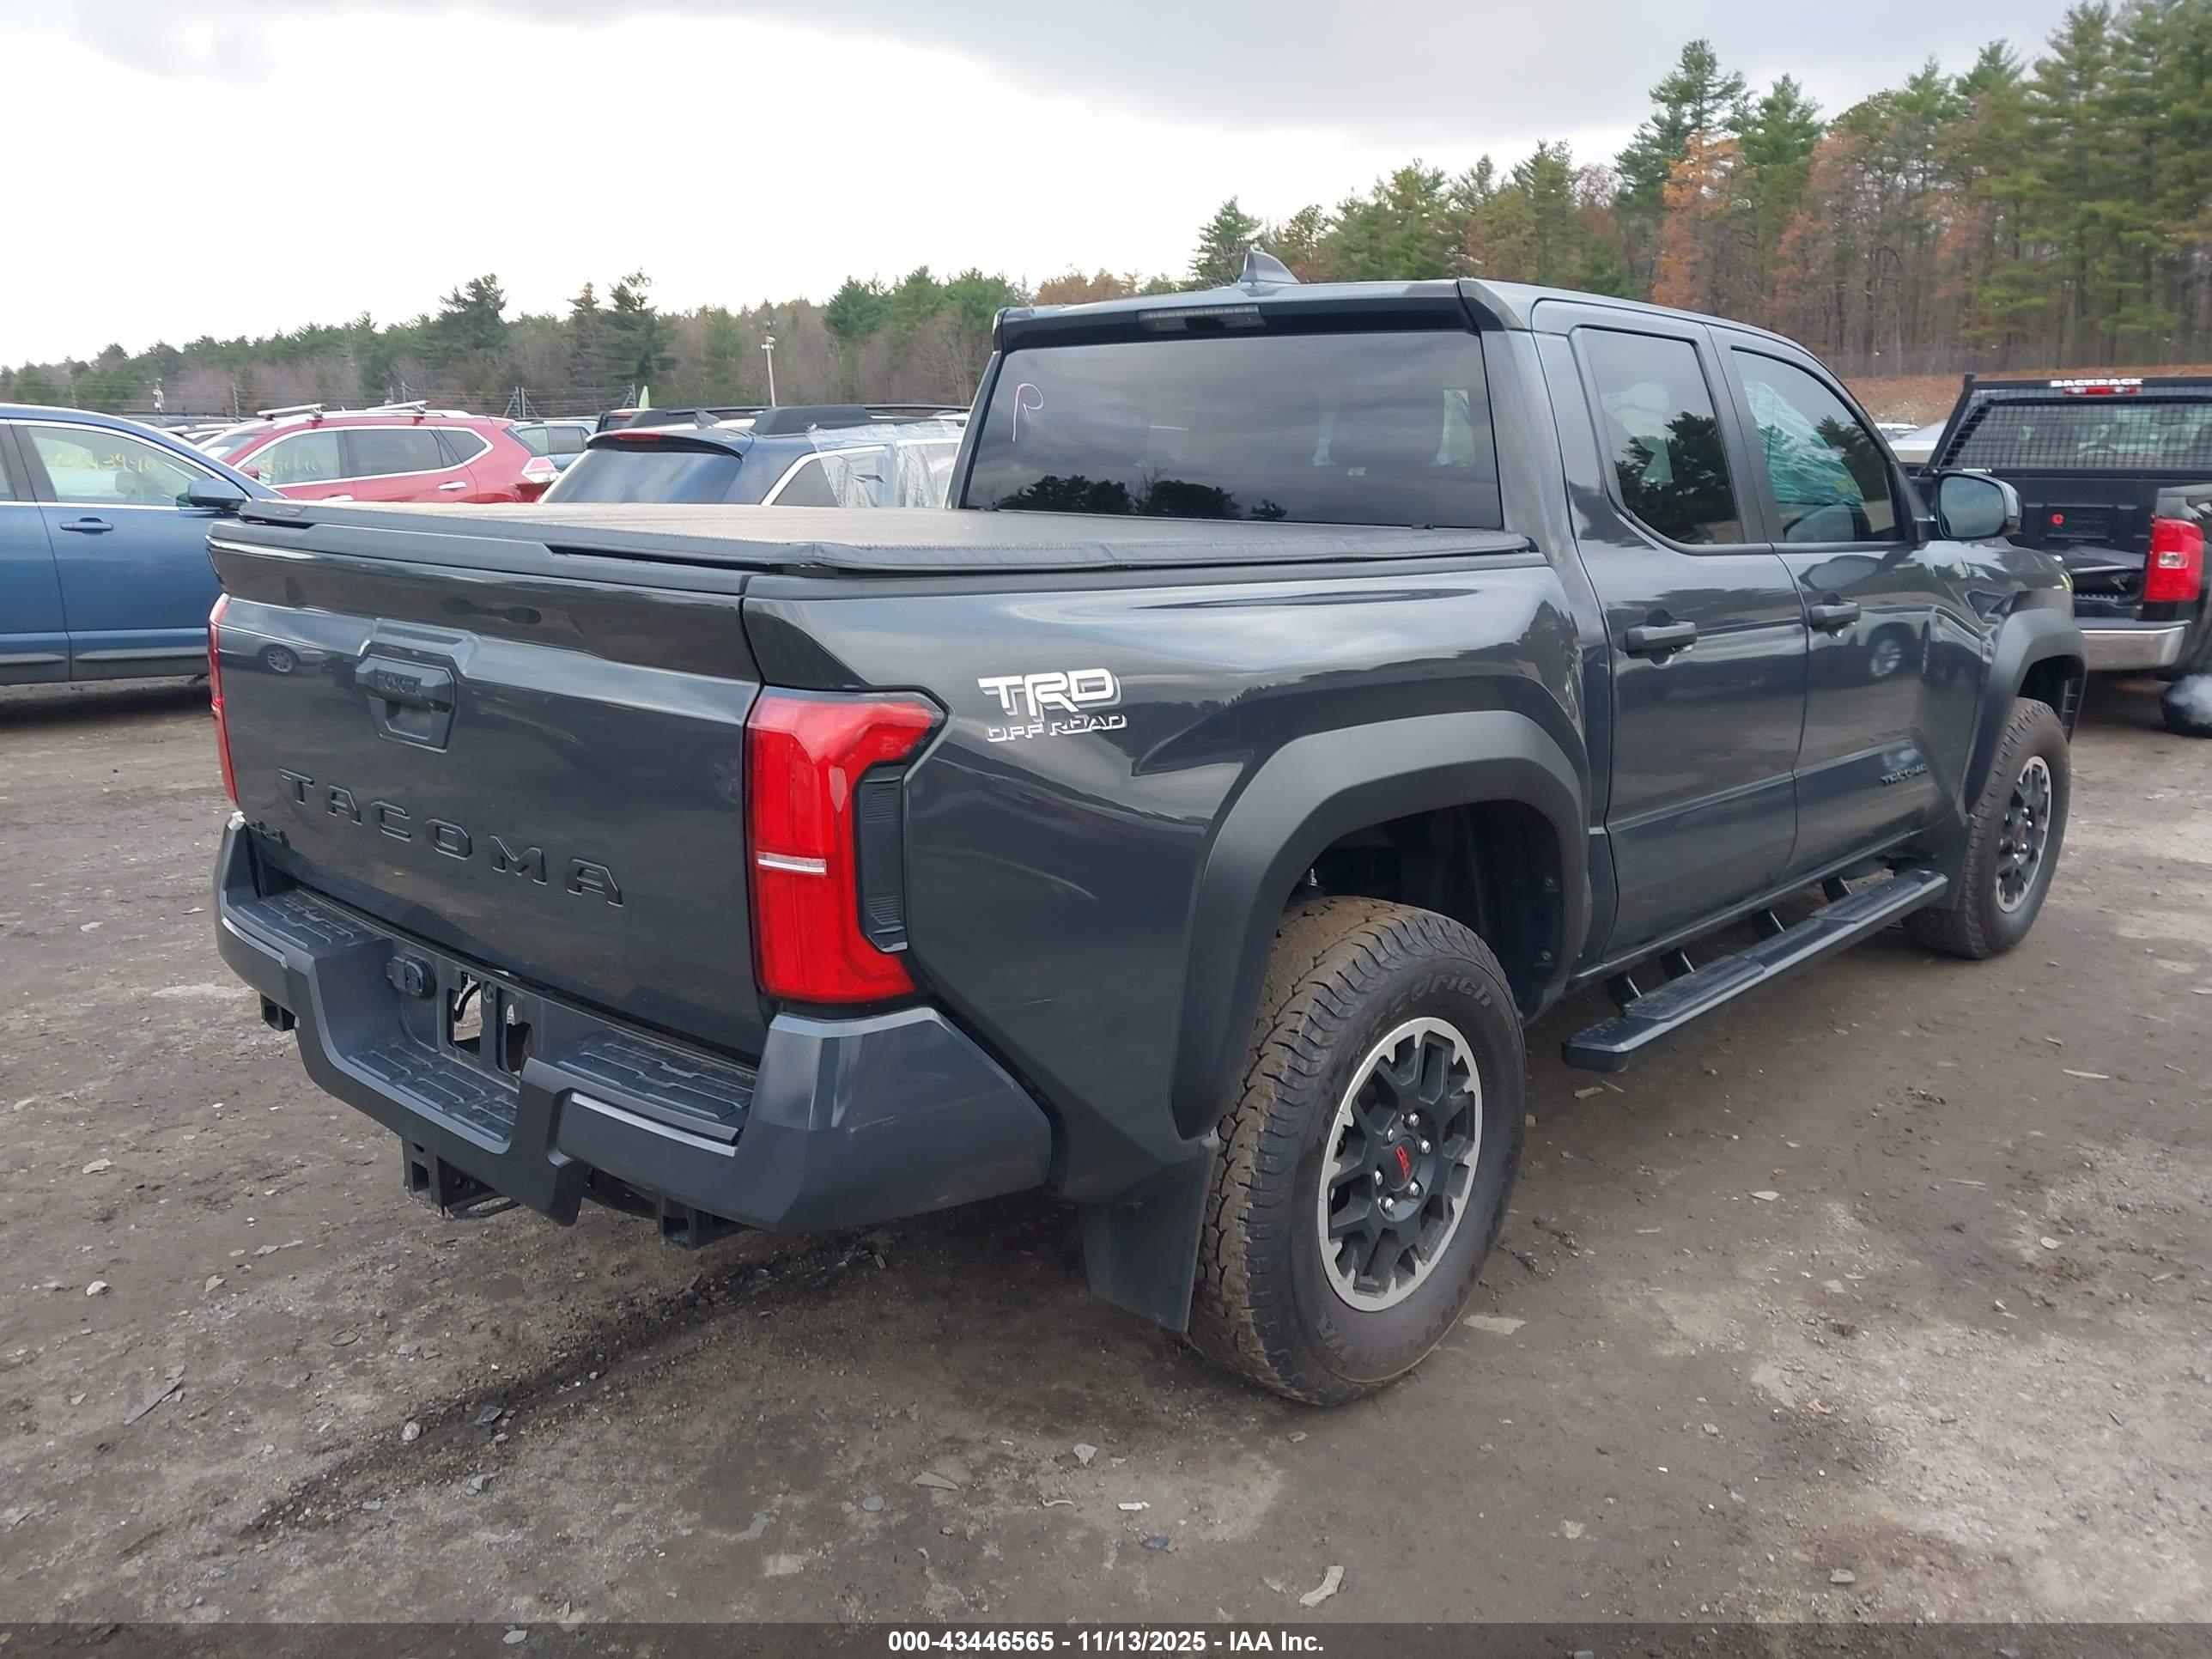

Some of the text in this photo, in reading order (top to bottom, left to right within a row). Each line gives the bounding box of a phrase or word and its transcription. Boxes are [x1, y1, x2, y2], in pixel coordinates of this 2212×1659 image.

[2050, 378, 2143, 387] BACKRACK
[977, 668, 1121, 723] TRD
[988, 713, 1129, 743] OFF ROAD
[277, 767, 624, 907] TACOMA
